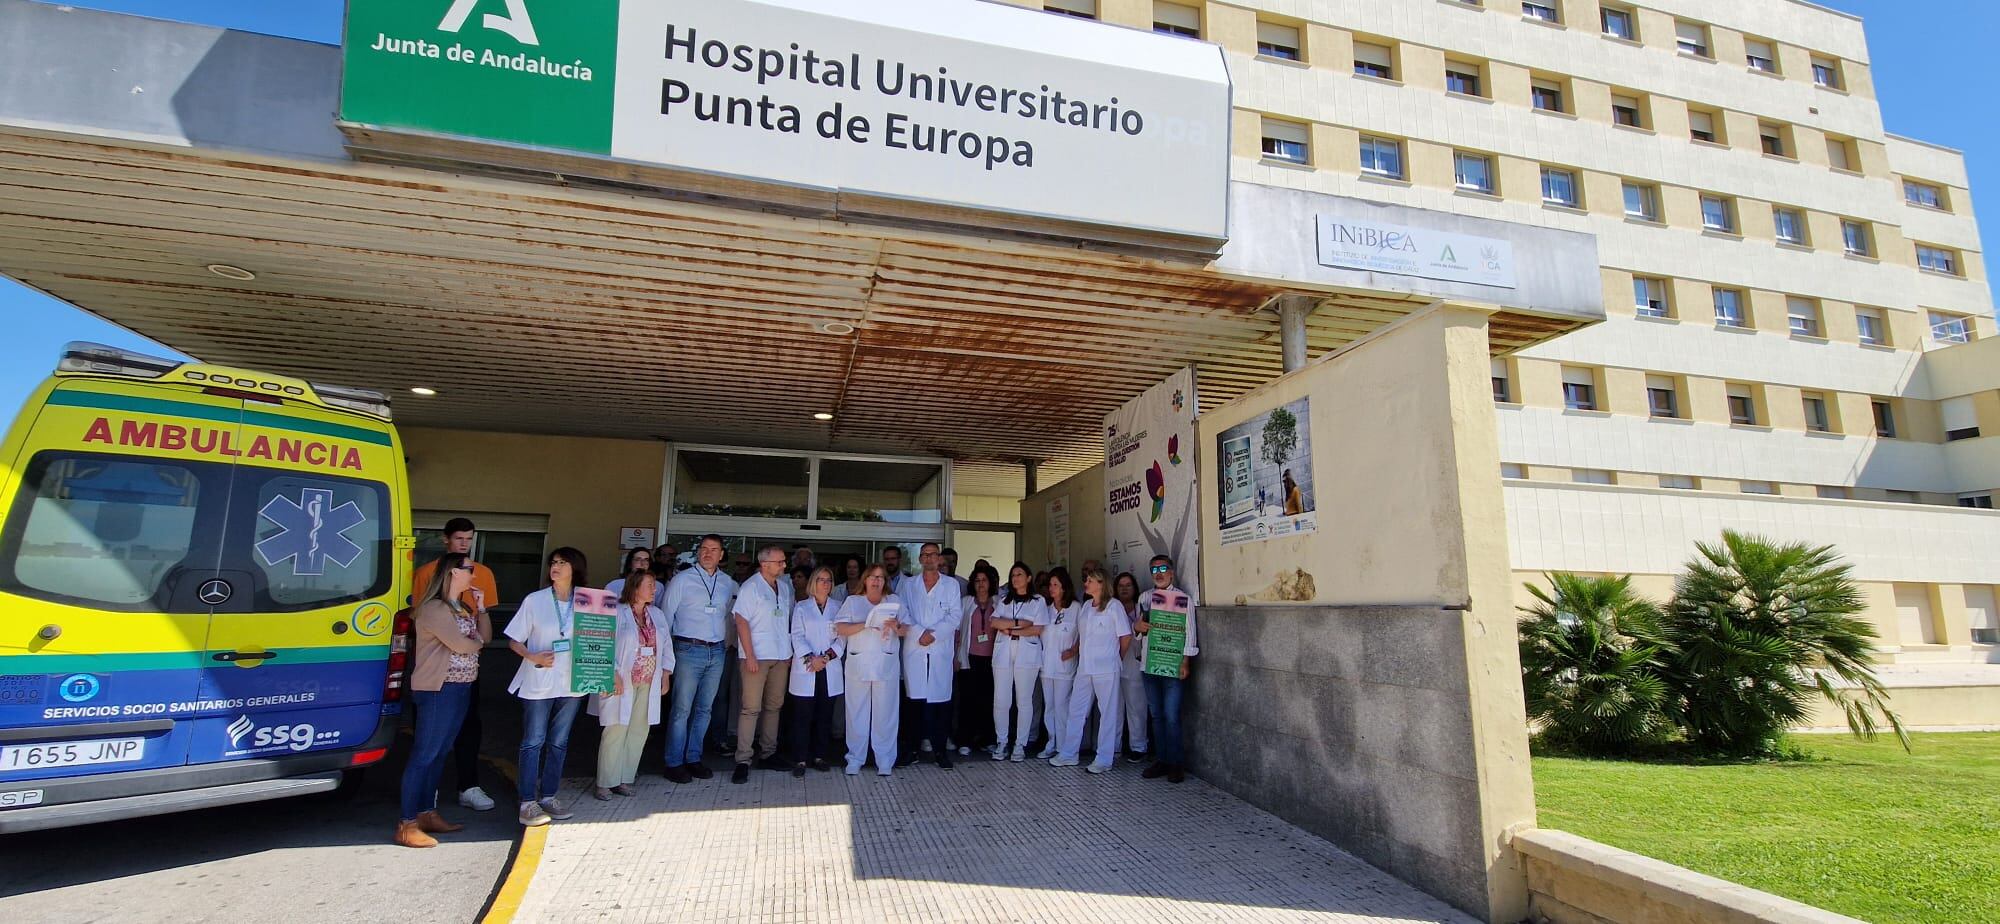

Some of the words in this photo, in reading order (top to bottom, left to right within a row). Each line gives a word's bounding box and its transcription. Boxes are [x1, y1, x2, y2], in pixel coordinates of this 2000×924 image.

[371, 33, 440, 58] Junta
[446, 43, 476, 64] de
[479, 48, 593, 81] Andalucía
[664, 23, 861, 91] Hospital
[876, 58, 1144, 136] Universitario
[660, 78, 801, 134] Punta
[816, 102, 871, 144] de
[885, 112, 1034, 171] Europa
[1331, 223, 1418, 253] INiBICA
[82, 417, 363, 471] AMBULANCIA
[1109, 481, 1141, 502] ESTAMOS
[1109, 495, 1141, 515] CONTIGO
[588, 644, 601, 652] NO
[1161, 635, 1171, 643] NO
[43, 705, 120, 719] SERVICIOS
[123, 703, 166, 716] SOCIO
[169, 698, 244, 713] SANITARIOS
[246, 692, 315, 707] GENERALES
[12, 744, 78, 767] 1655
[89, 741, 138, 761] JNP
[1, 791, 38, 805] SP
